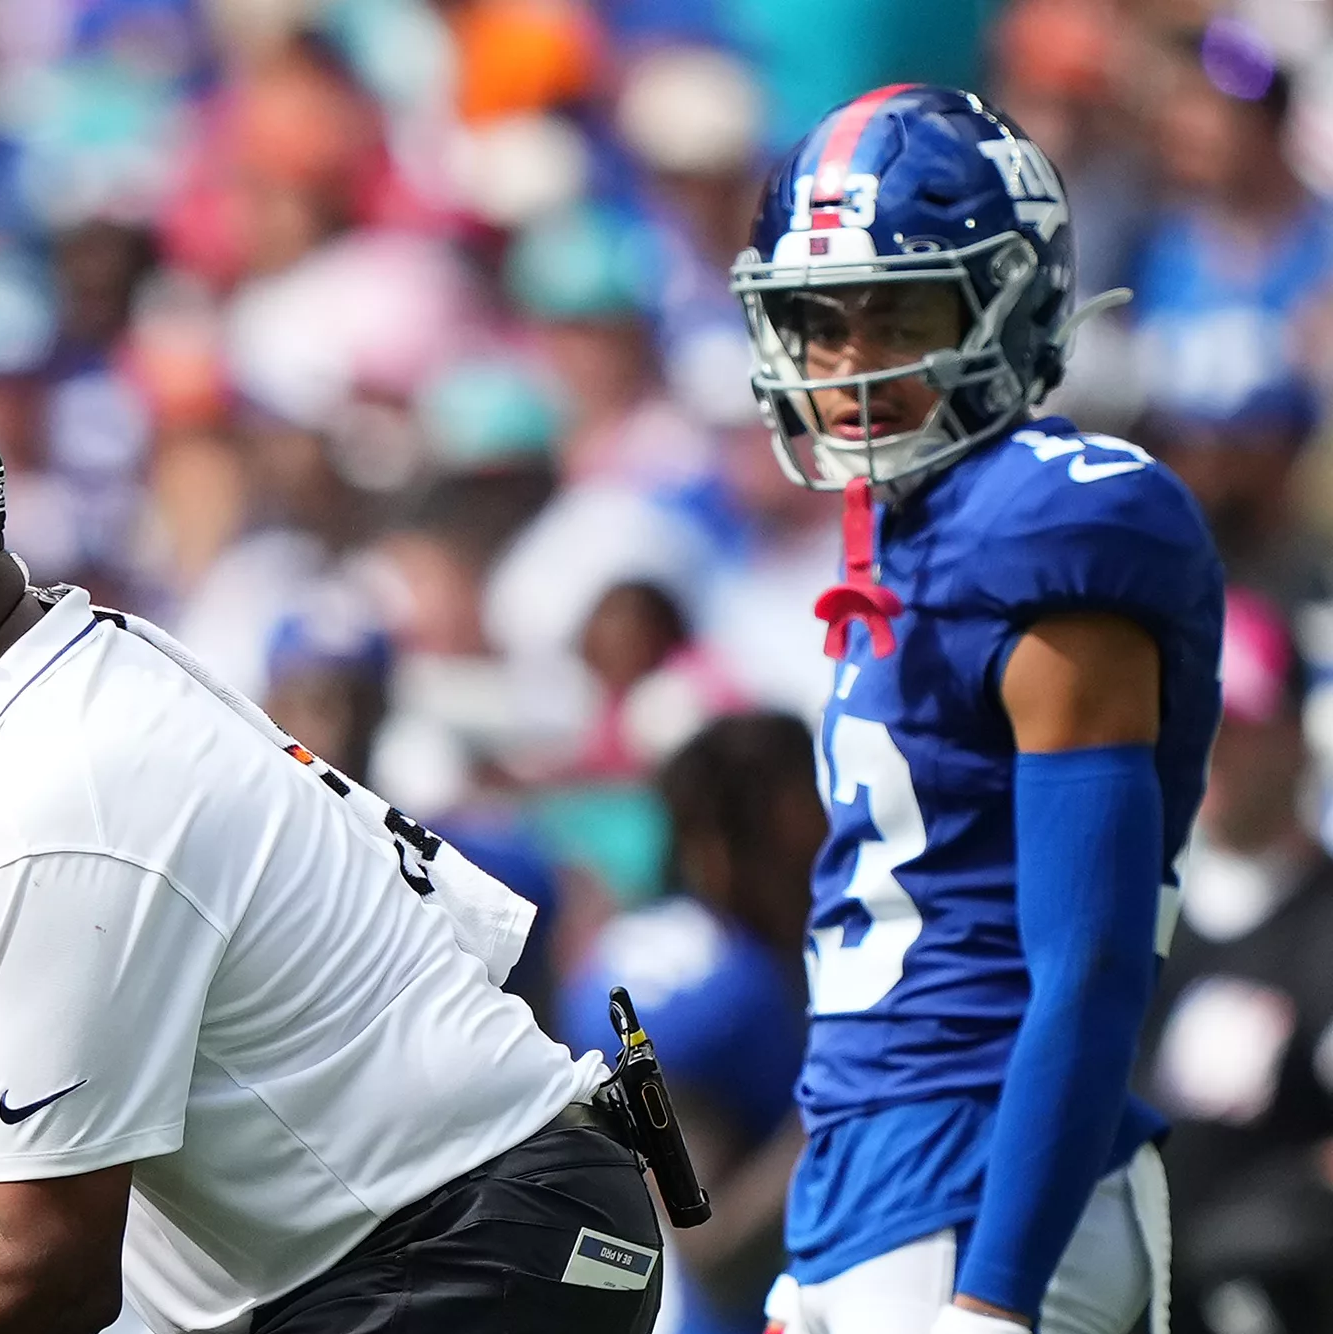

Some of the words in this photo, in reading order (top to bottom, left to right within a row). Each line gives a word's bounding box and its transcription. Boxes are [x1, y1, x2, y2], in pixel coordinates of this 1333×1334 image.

[789, 173, 880, 231] 13
[600, 1246, 617, 1260] PRO
[616, 1252, 623, 1262] A
[621, 1253, 633, 1266] BE
